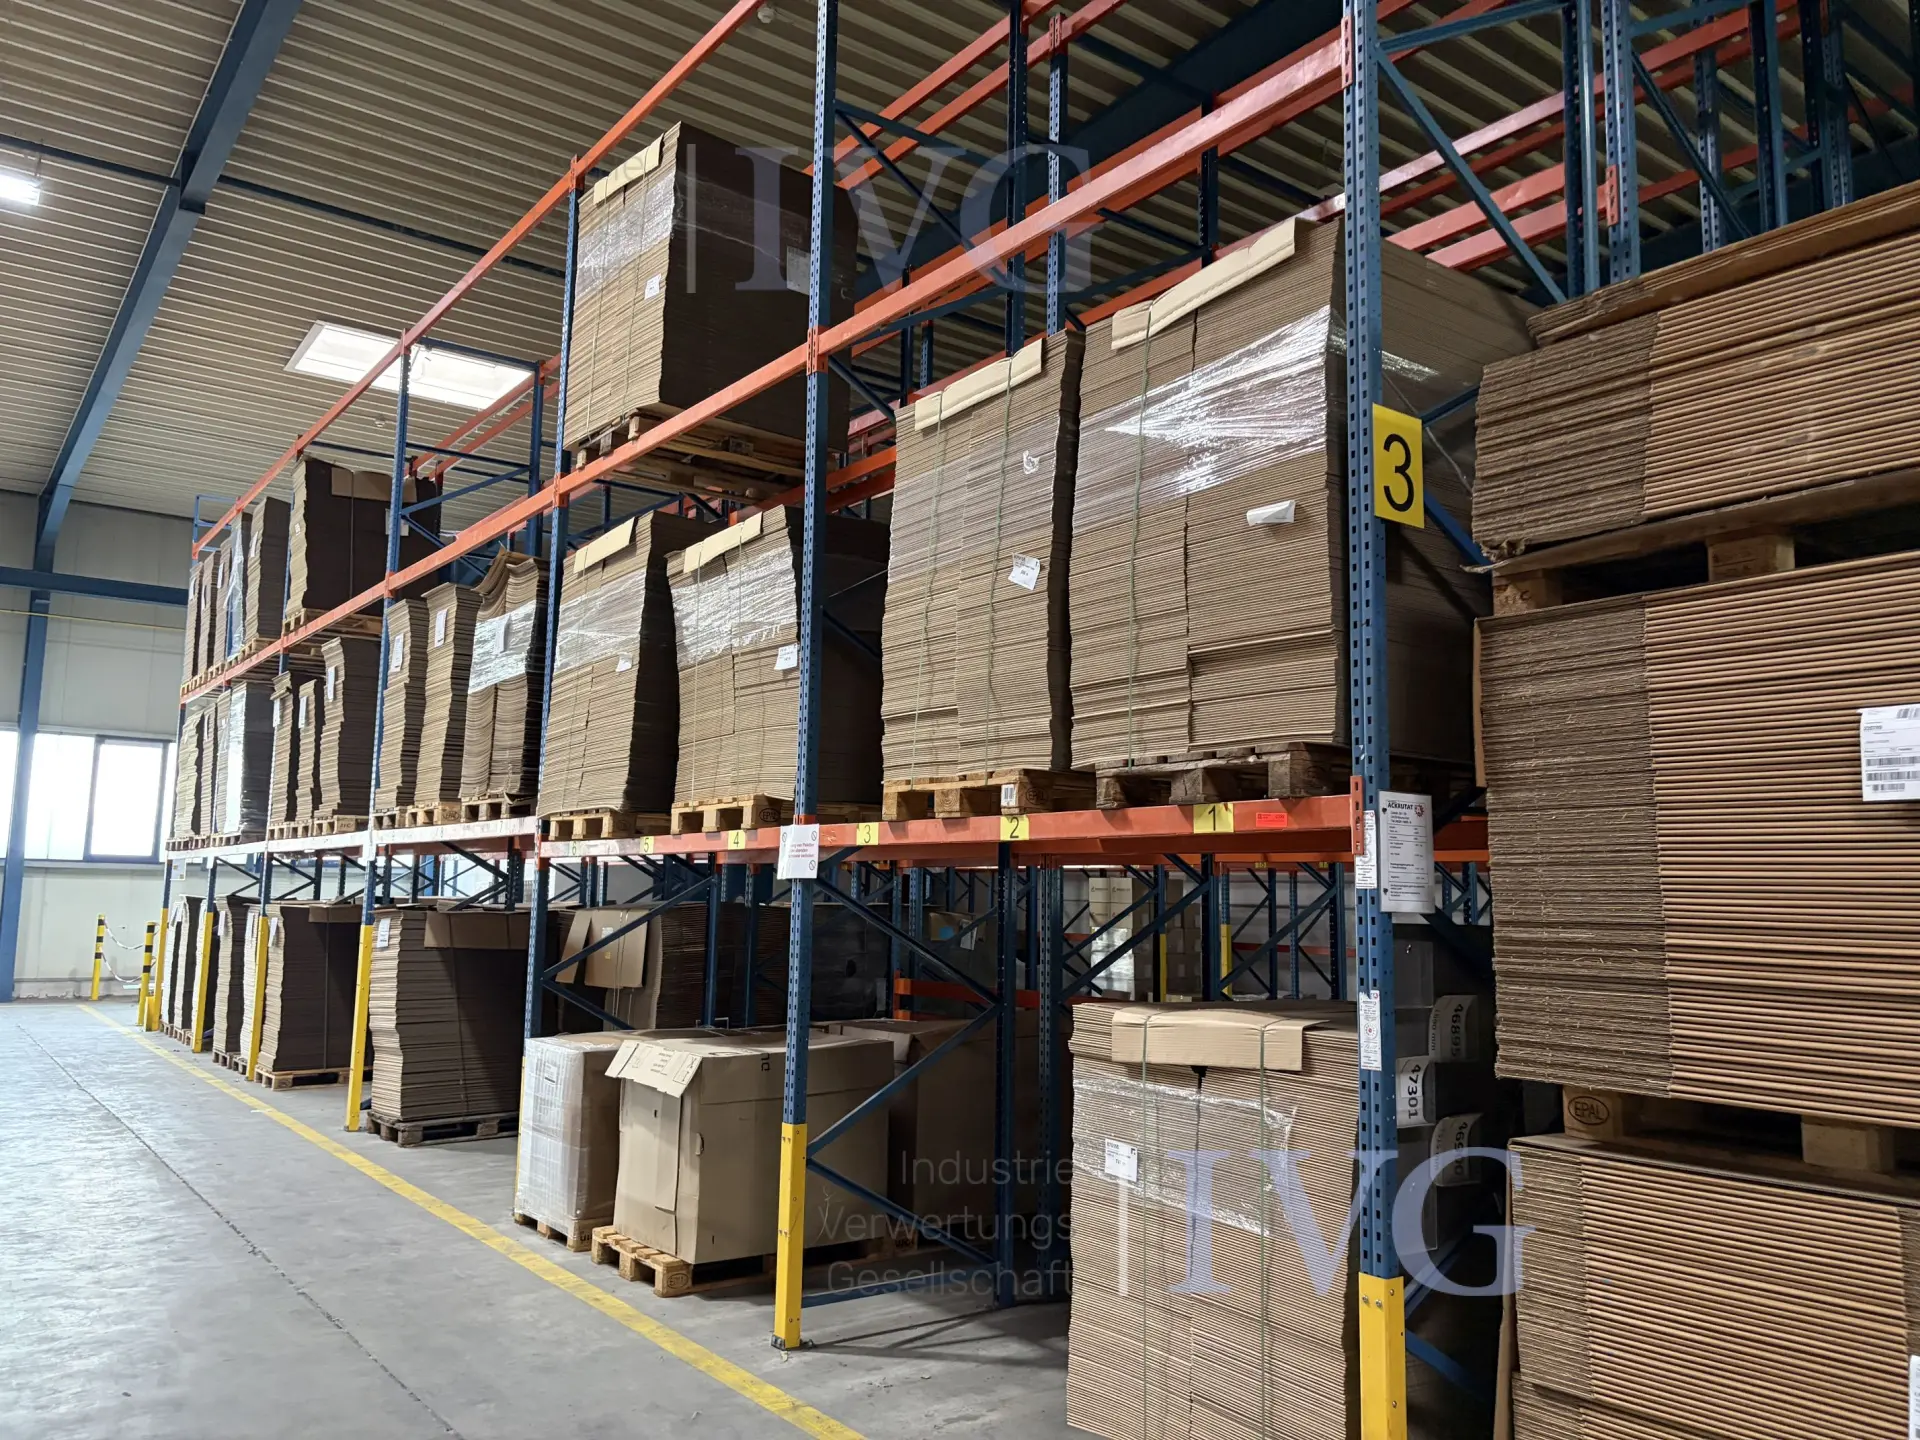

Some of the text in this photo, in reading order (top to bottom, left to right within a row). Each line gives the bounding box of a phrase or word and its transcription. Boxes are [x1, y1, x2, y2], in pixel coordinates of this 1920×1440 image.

[1383, 433, 1415, 513] 3
[1009, 816, 1020, 839] 2
[1207, 804, 1217, 832] 1
[643, 836, 650, 853] 5
[732, 831, 740, 848] 4
[863, 824, 872, 844] 3
[571, 840, 577, 856] 6
[1450, 1003, 1465, 1058] 46895
[1407, 1064, 1422, 1120] 47301
